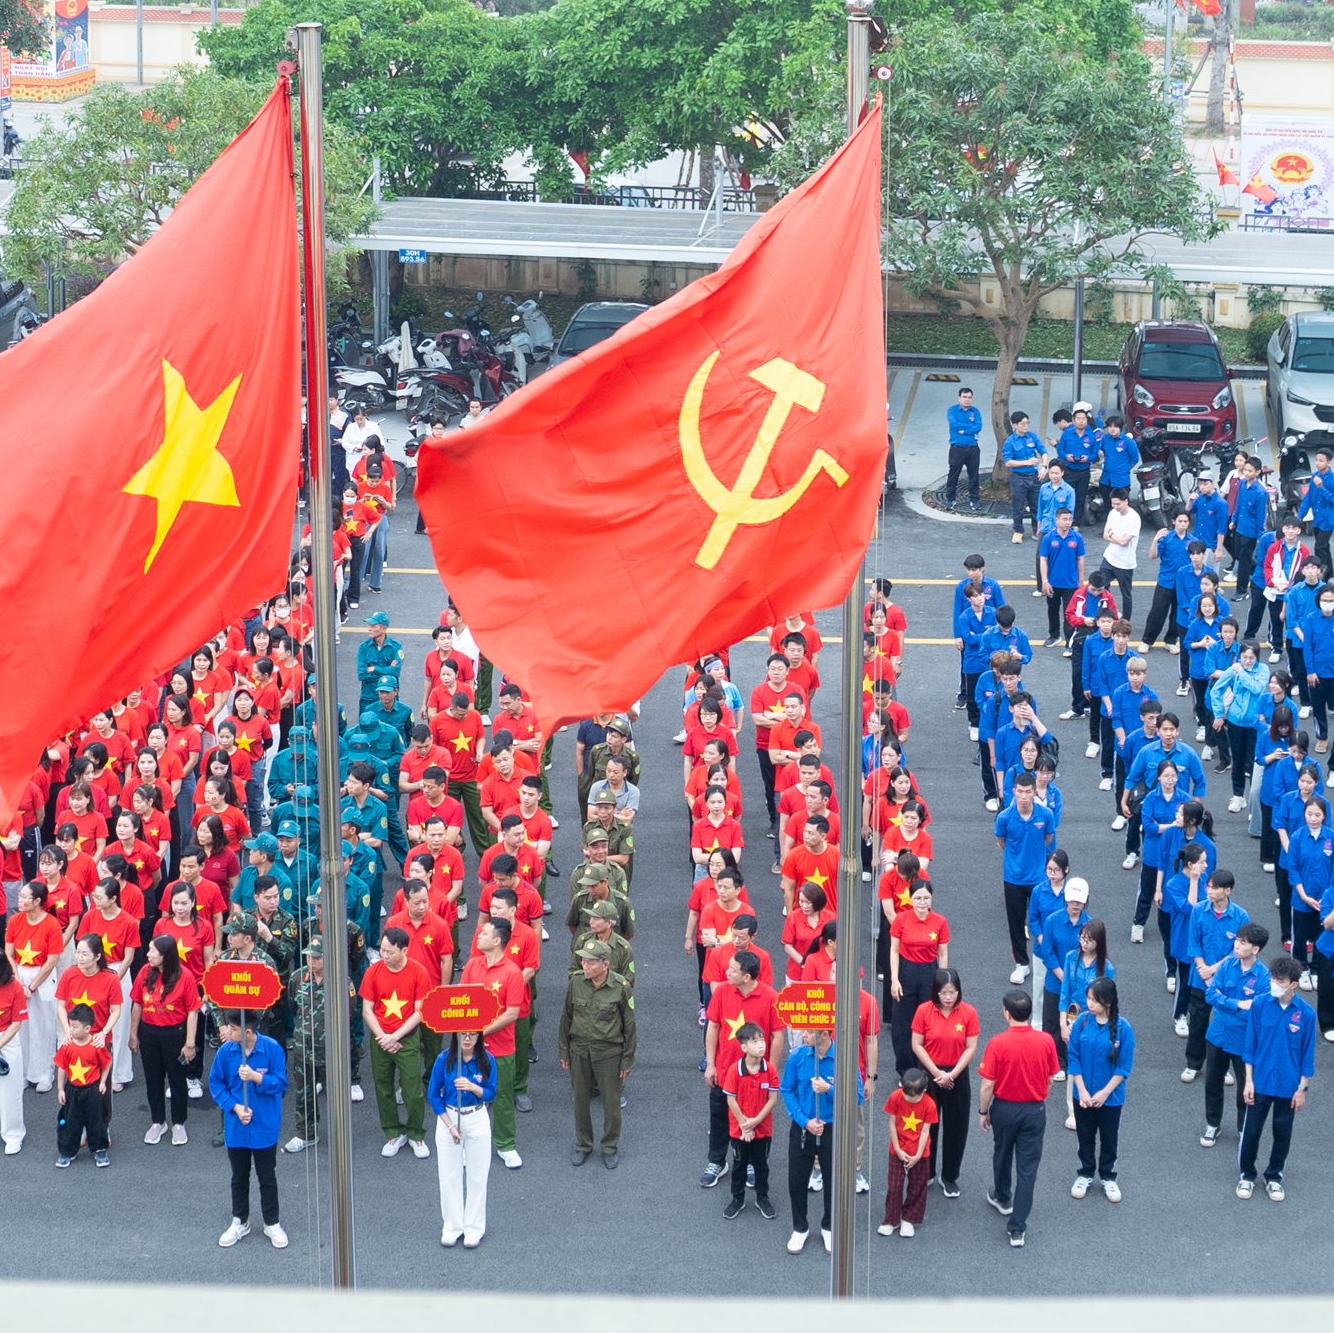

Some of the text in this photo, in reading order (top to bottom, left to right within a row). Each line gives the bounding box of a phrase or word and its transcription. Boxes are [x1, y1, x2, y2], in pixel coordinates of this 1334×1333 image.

[231, 970, 251, 982] KHỐI
[223, 983, 261, 997] QUÂN SỰ
[806, 987, 825, 998] KHỐI
[450, 993, 470, 1005] KHỐI
[778, 1000, 795, 1011] CÁN
[796, 1000, 809, 1012] BỘ,
[810, 1000, 831, 1012] CÔNG
[441, 1007, 479, 1019] CÔNG AN
[790, 1013, 808, 1024] VIÊN
[809, 1013, 829, 1024] CHỨC
